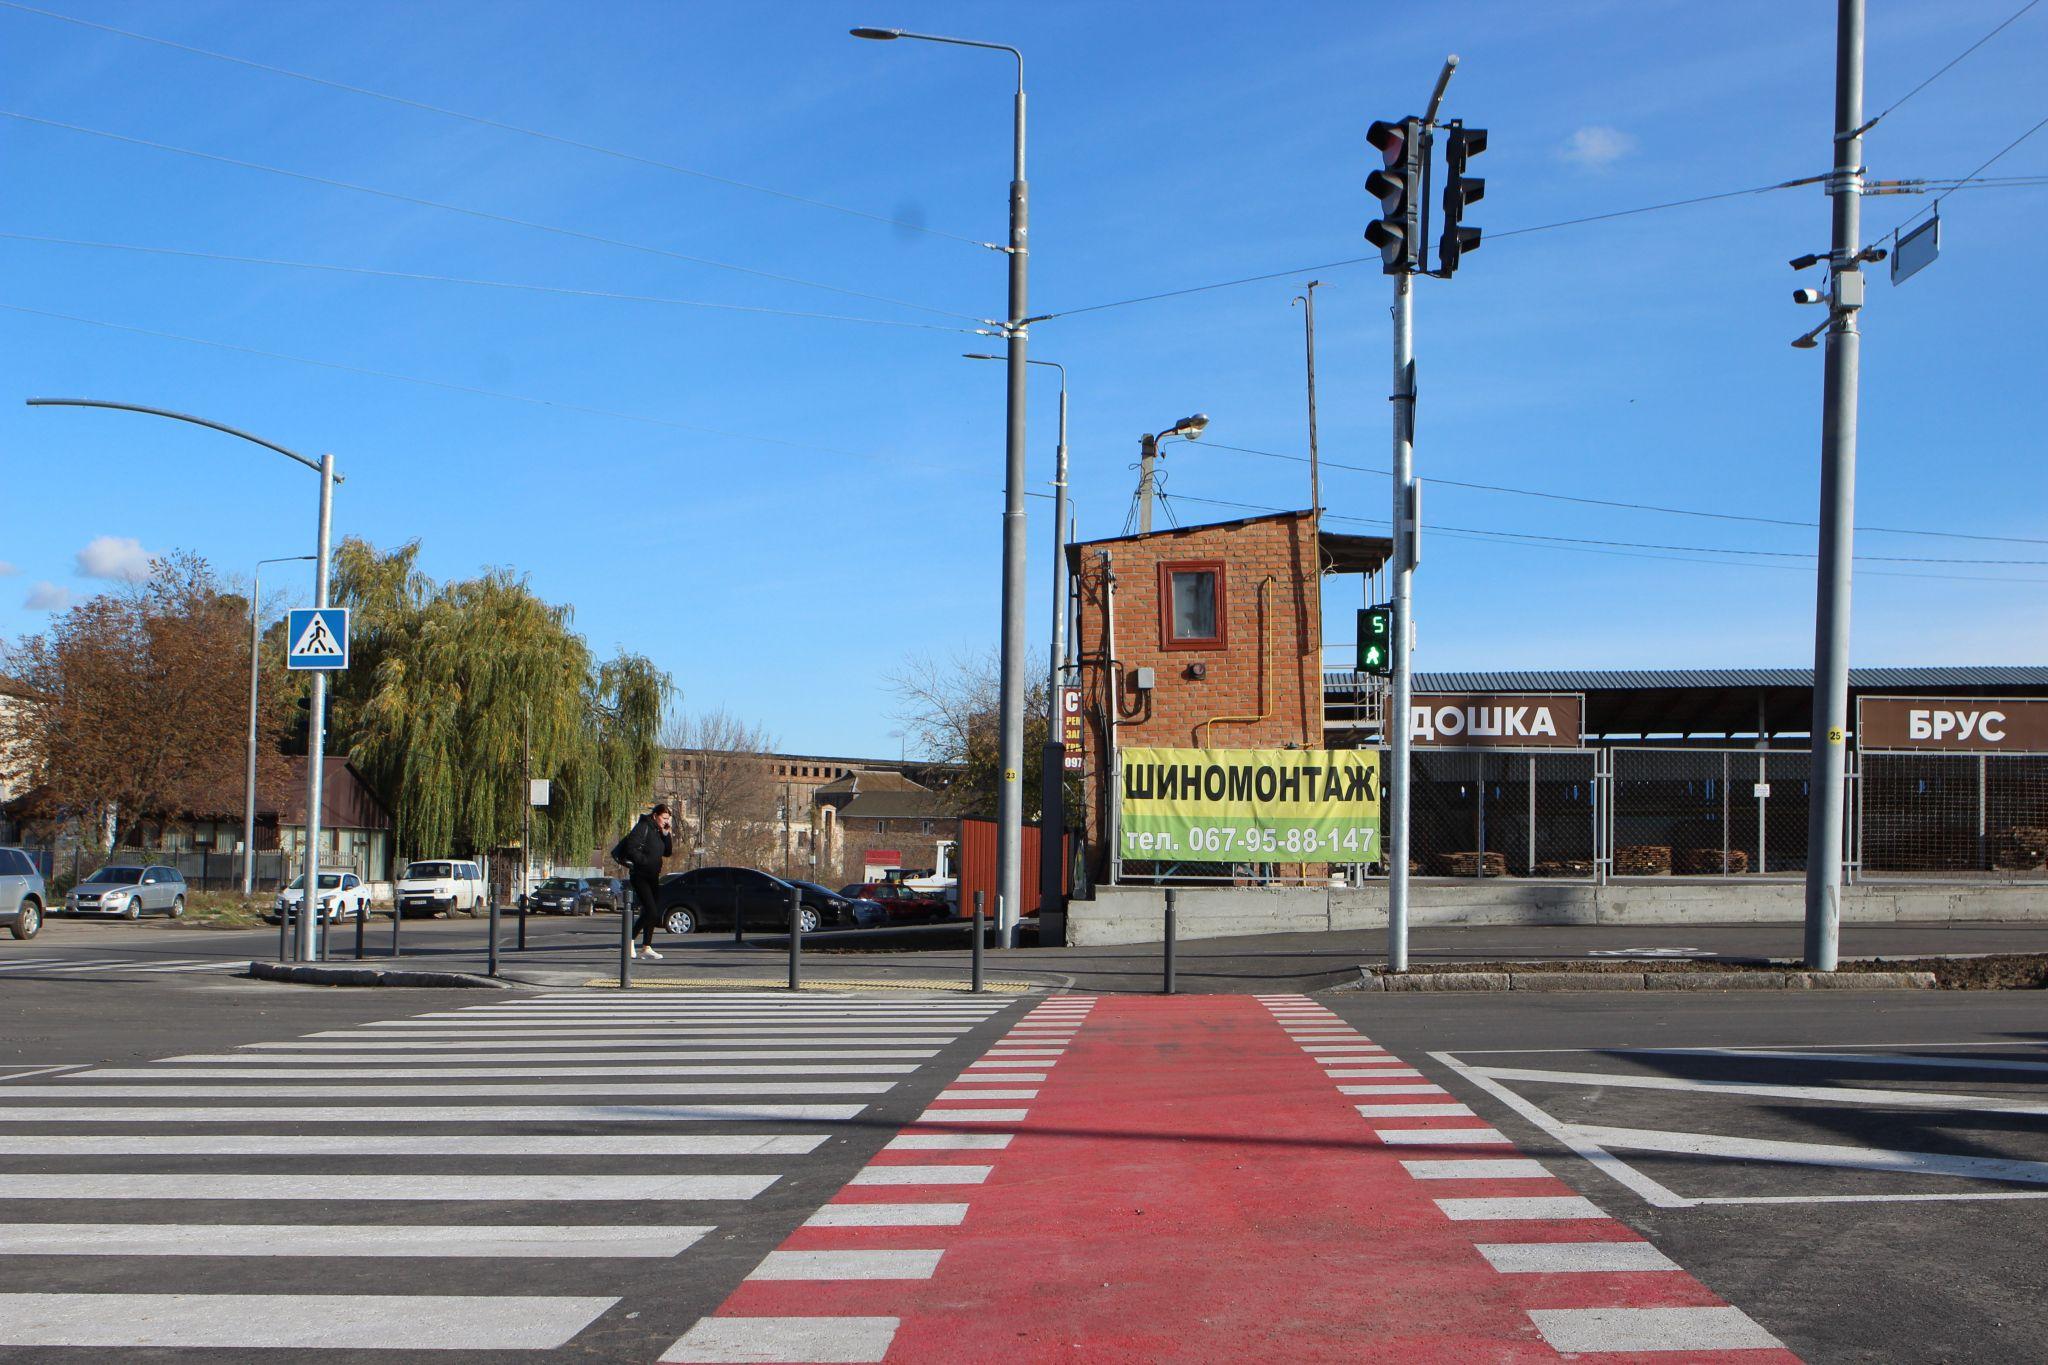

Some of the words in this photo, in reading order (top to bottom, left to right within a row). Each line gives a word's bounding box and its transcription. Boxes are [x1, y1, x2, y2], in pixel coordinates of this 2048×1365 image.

[1372, 616, 1384, 633] 5
[1065, 691, 1081, 712] С
[1410, 705, 1557, 741] ДОШКА
[1830, 731, 1841, 740] 25
[1909, 709, 2006, 742] БРУС
[1125, 763, 1376, 802] ШИНОМОНТАЖ
[1126, 829, 1179, 851] тел.
[1188, 826, 1375, 853] 067-95-88-147
